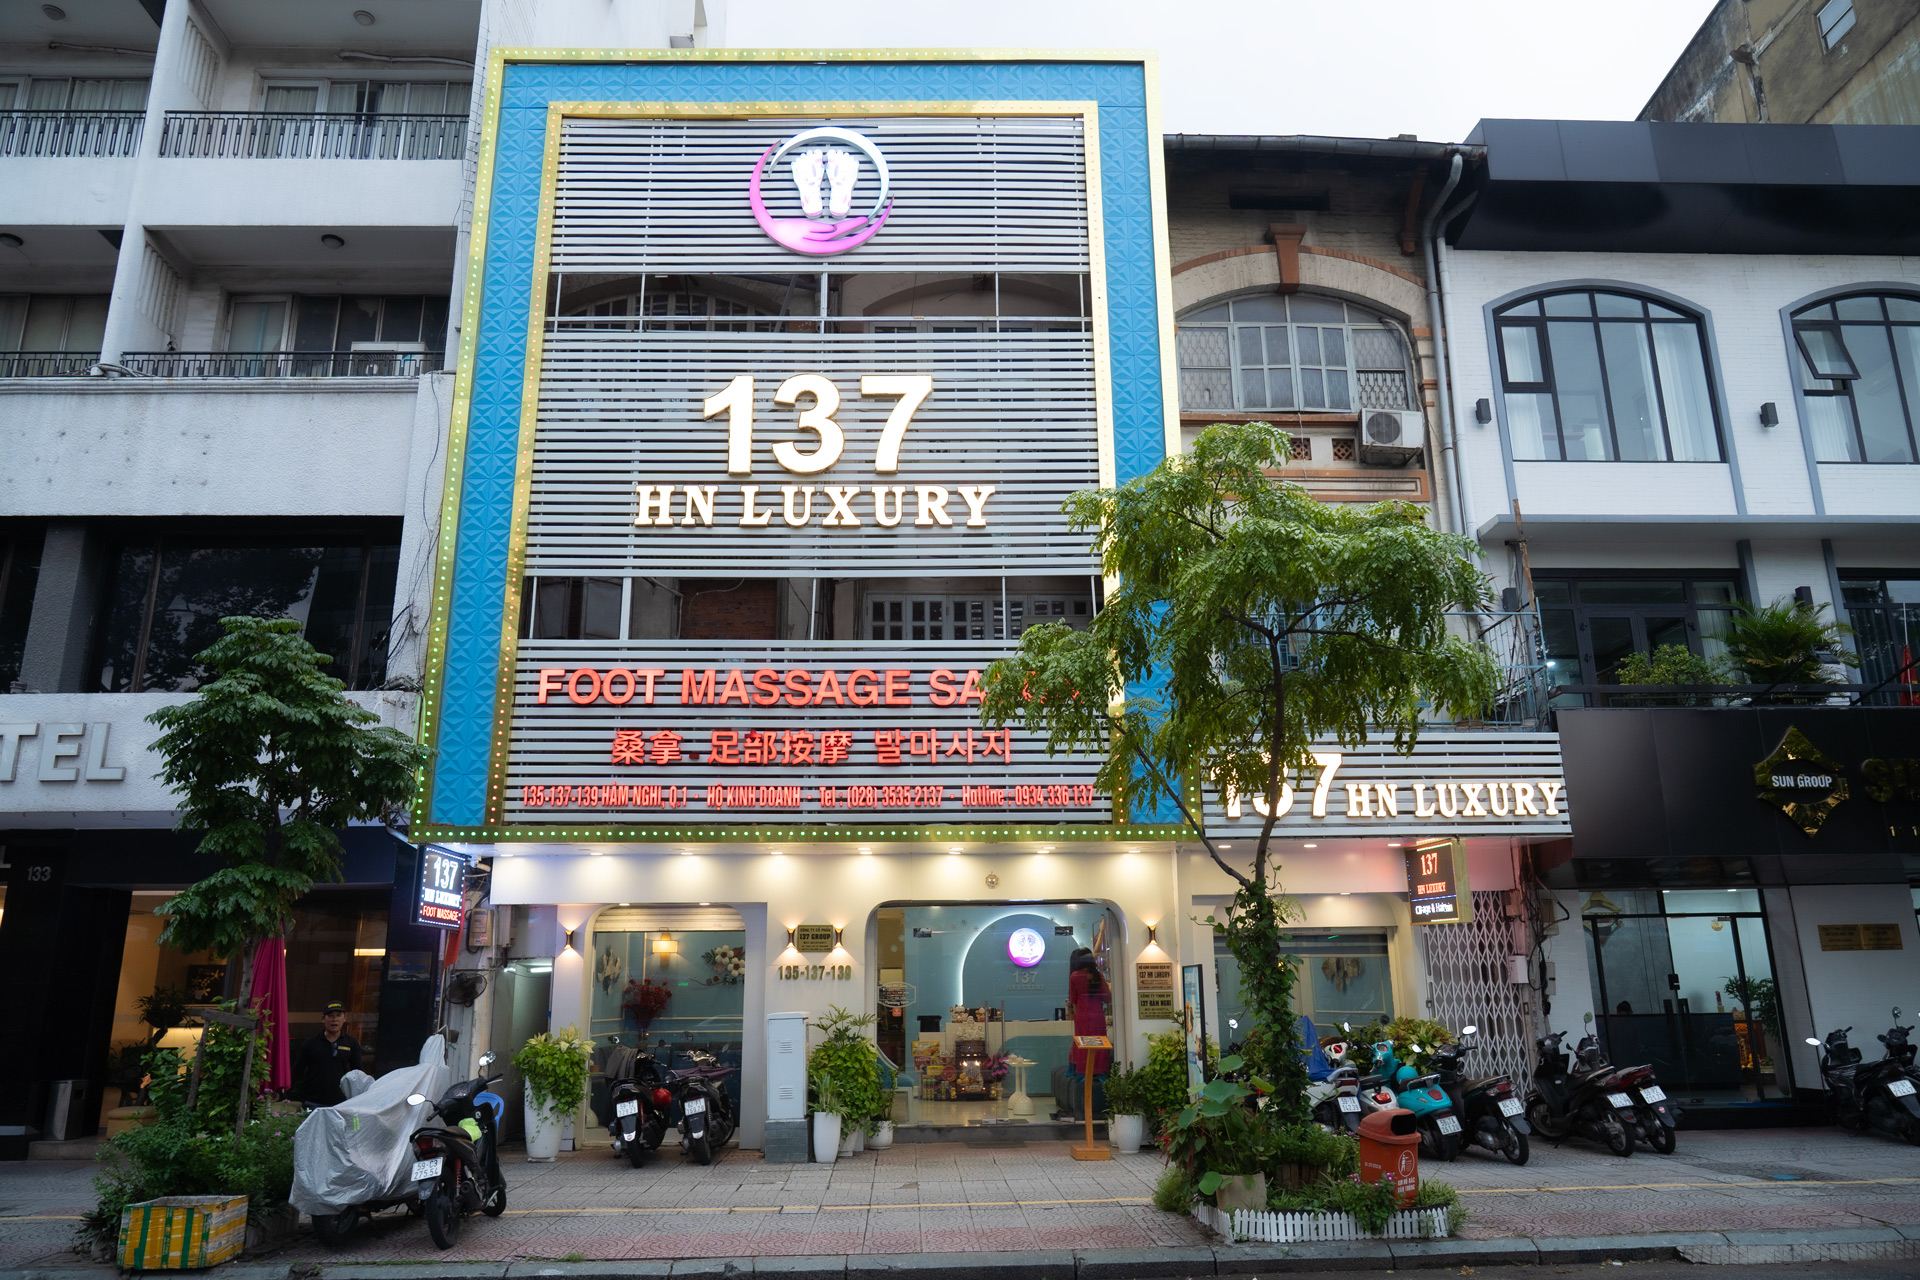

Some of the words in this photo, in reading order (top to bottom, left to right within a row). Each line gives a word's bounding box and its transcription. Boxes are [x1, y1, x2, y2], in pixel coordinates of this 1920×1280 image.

[702, 373, 934, 476] 137
[633, 485, 719, 528] HN
[739, 485, 996, 528] LUXURY
[537, 668, 665, 706] FOOT
[680, 668, 912, 706] MASSAGE
[874, 728, 1011, 764] 발마사지
[1771, 775, 1795, 788] SUN
[1797, 775, 1833, 788] GROUP
[522, 785, 599, 807] 135-137-139
[632, 785, 666, 809] NGHI,
[668, 785, 687, 808] Q.1
[706, 782, 724, 811] HỘ
[726, 785, 756, 807] KINH
[759, 786, 801, 807] DOANH
[847, 785, 878, 809] (028)
[882, 786, 912, 807] 3535
[914, 786, 944, 807] 2137
[1015, 785, 1045, 807] 0934
[1047, 785, 1070, 807] 336
[1072, 785, 1095, 807] 137
[1345, 783, 1398, 817] HN
[1412, 782, 1562, 818] LUXURY
[27, 865, 52, 882] 133
[433, 856, 459, 890] 137
[1420, 852, 1438, 875] 137
[423, 905, 437, 918] FOOT
[437, 907, 459, 922] MASSAGE
[778, 965, 852, 980] 135-137-139
[1012, 970, 1039, 984] 137
